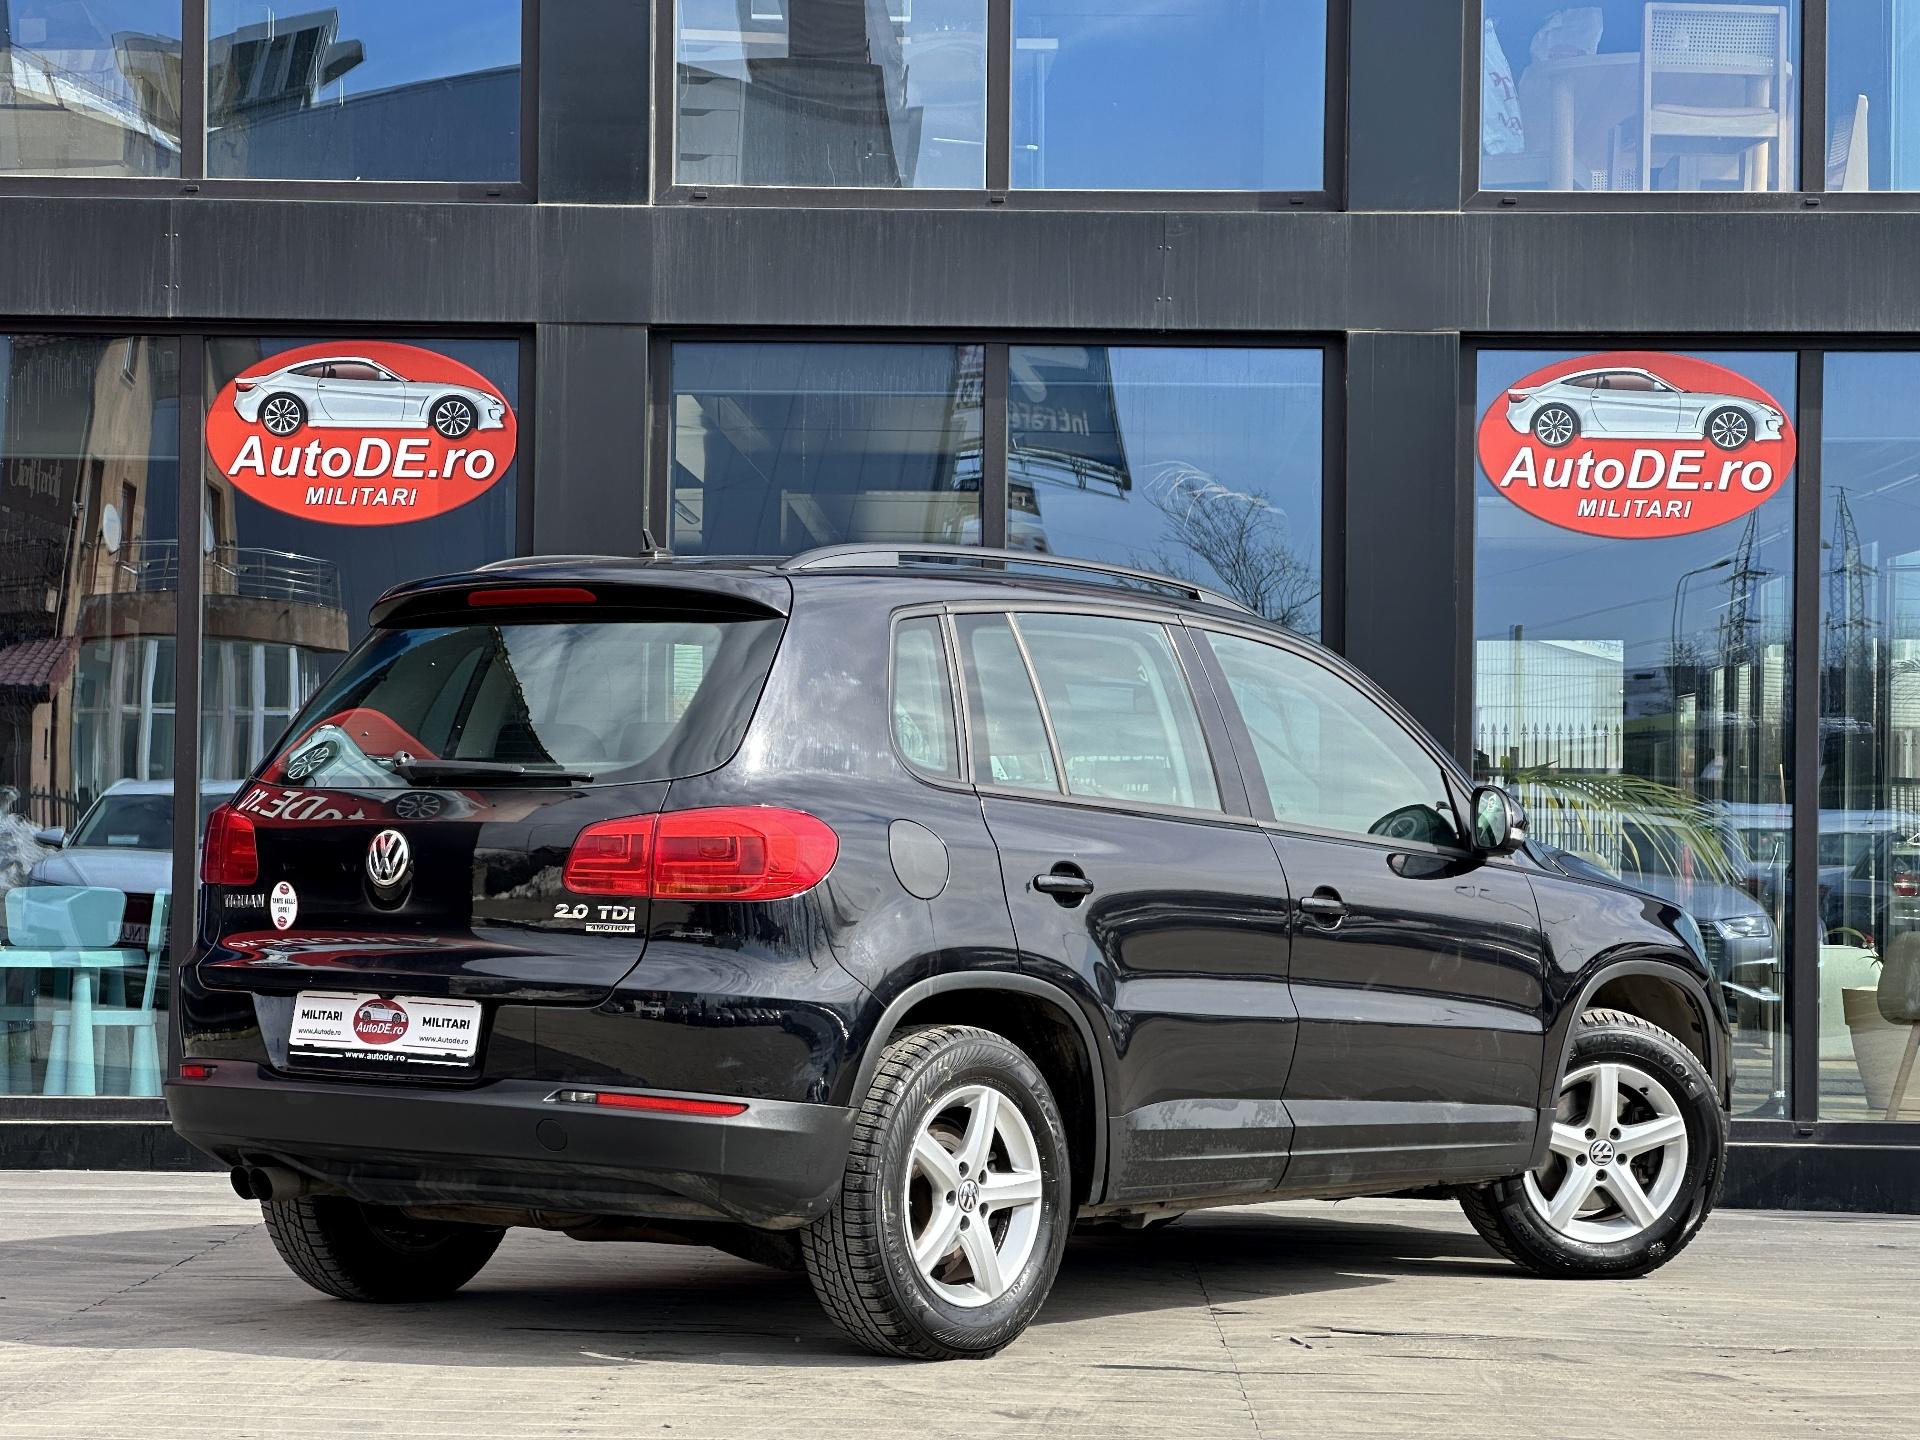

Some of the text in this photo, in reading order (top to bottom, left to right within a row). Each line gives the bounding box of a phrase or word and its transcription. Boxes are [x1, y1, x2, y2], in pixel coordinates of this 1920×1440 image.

[228, 435, 496, 480] AutoDE.ro
[1500, 446, 1774, 492] AutoDE.ro
[305, 486, 418, 507] MILITARI
[1577, 499, 1693, 518] MILITARI
[224, 893, 265, 909] TIGUAN
[597, 905, 636, 921] TDI
[589, 924, 631, 932] 4MOTION
[301, 1009, 343, 1022] MILITARI
[422, 1016, 471, 1030] MILITARI
[298, 1027, 342, 1036] www.Autode.ro
[356, 1021, 404, 1036] AutoDE.ro
[419, 1035, 469, 1045] www.Autode.ro
[345, 1050, 406, 1062] www.autode.ro
